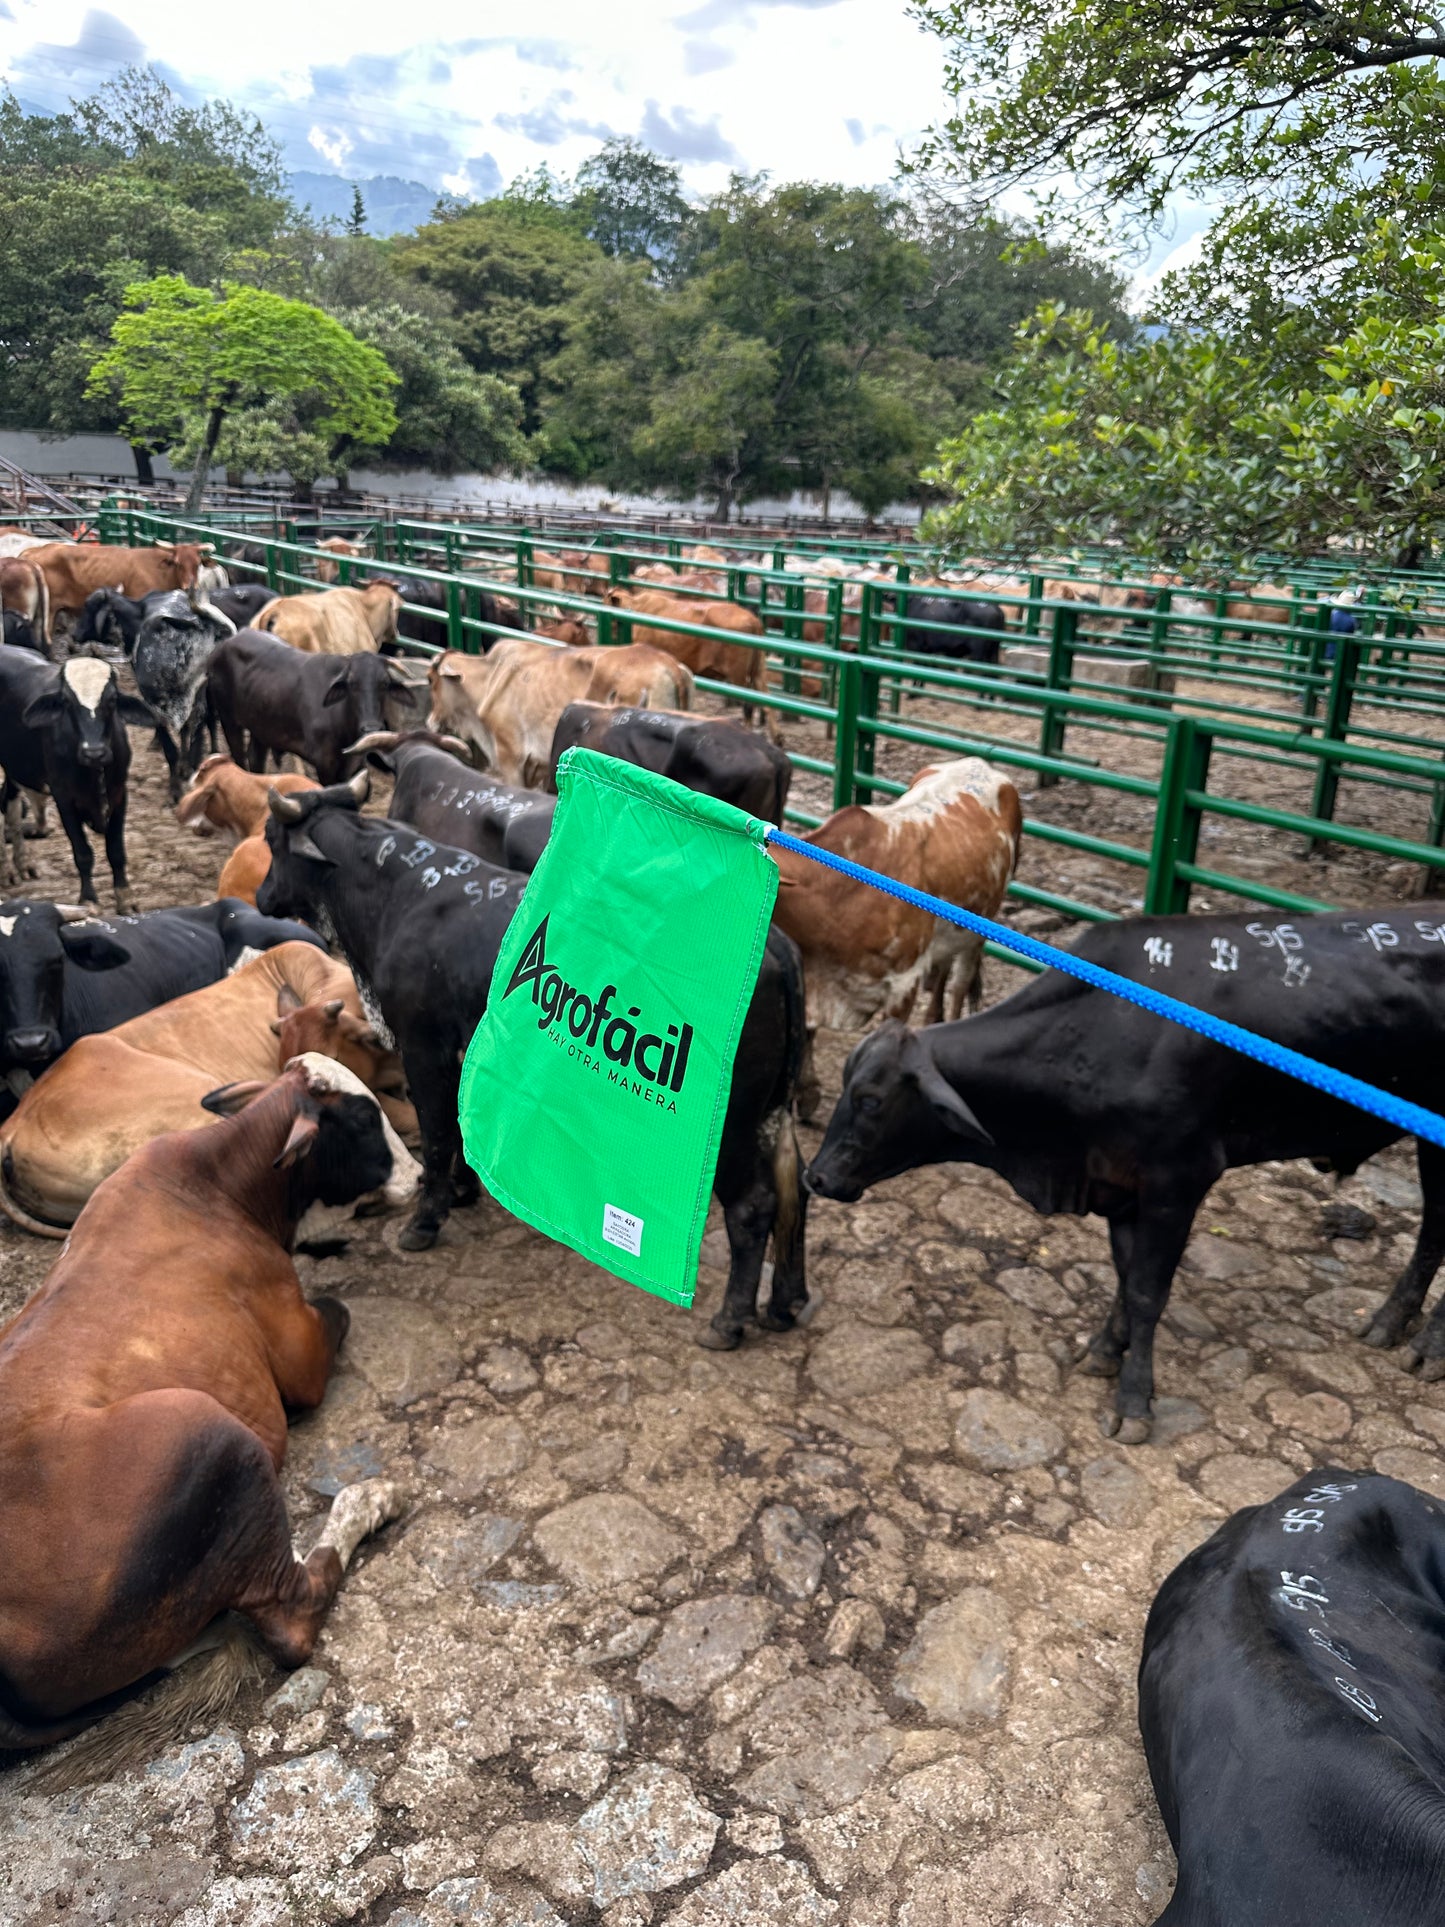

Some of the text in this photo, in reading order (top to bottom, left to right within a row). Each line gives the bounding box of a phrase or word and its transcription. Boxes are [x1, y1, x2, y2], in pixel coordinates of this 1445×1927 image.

[500, 911, 694, 1093] Agrofácil
[547, 1026, 677, 1114] HAY OTRA MANERA
[624, 1218, 636, 1228] 424
